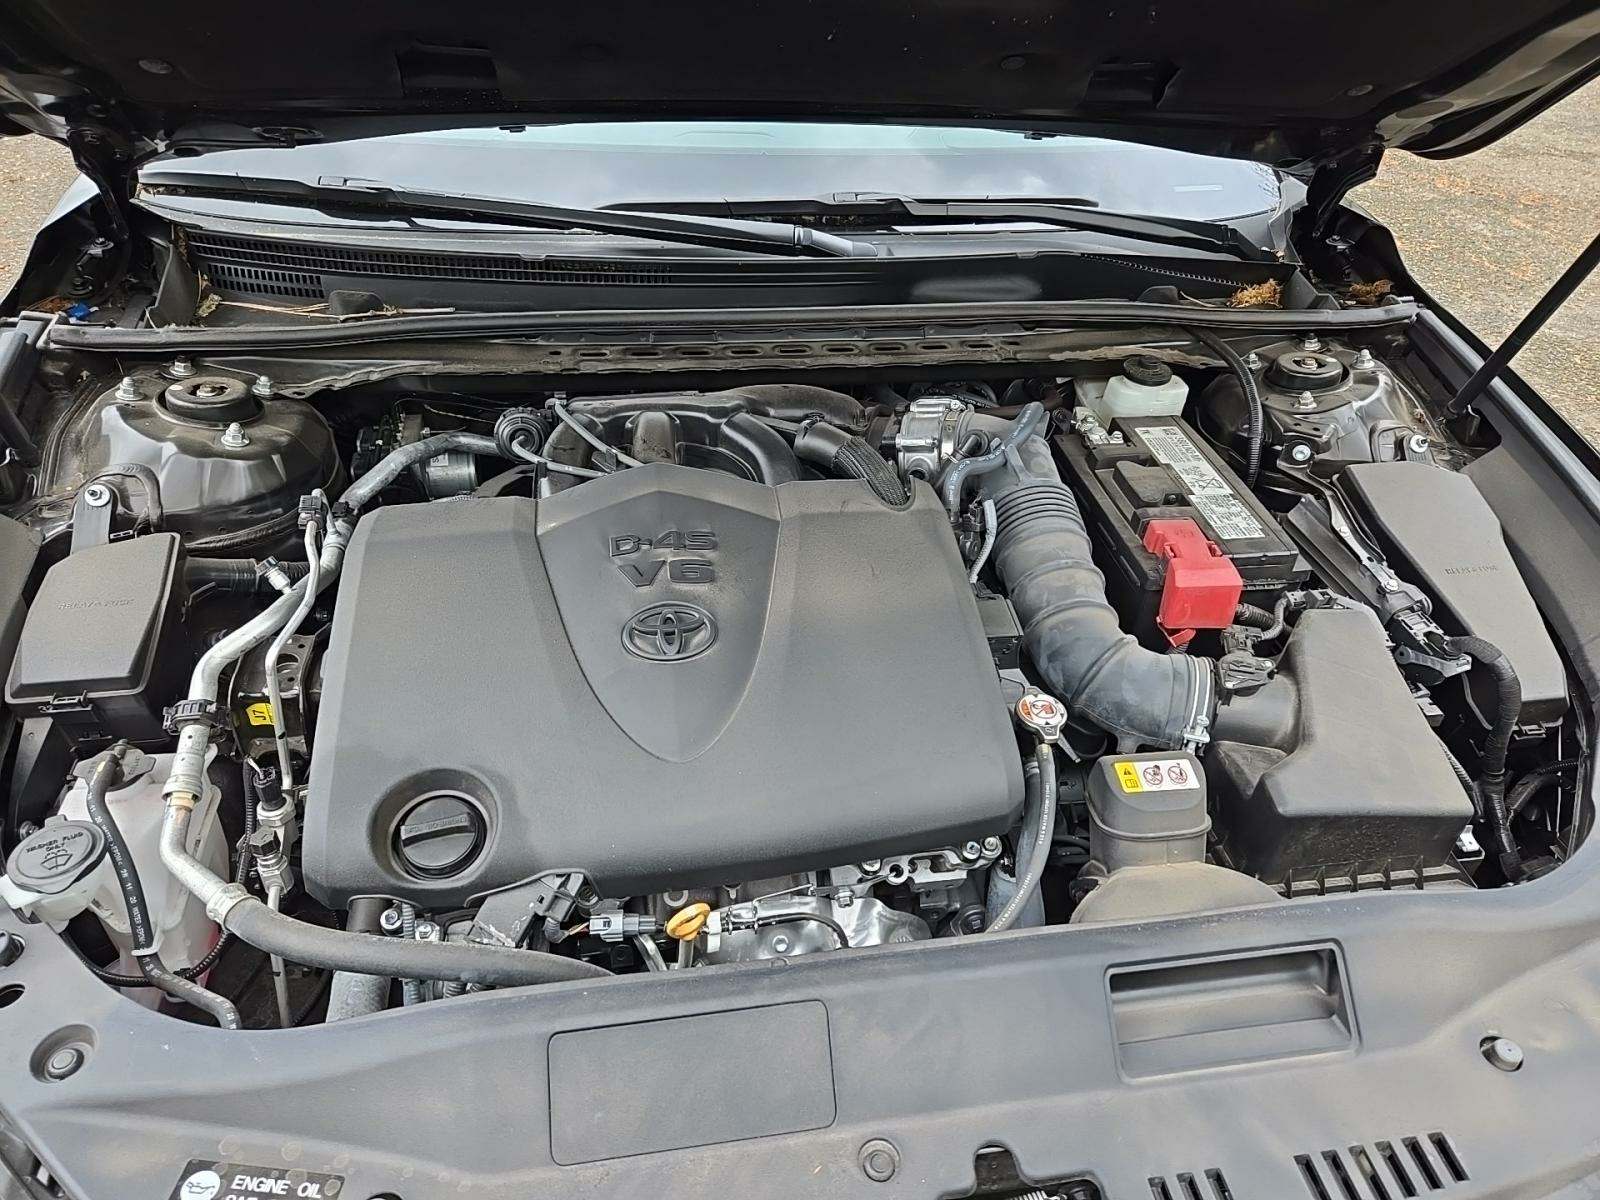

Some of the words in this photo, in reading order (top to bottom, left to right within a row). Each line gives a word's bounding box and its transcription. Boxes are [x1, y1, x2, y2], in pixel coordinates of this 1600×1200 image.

[609, 529, 718, 557] D-4S
[616, 557, 716, 588] V6
[230, 1174, 291, 1195] ENGINE
[297, 1181, 322, 1199] OIL
